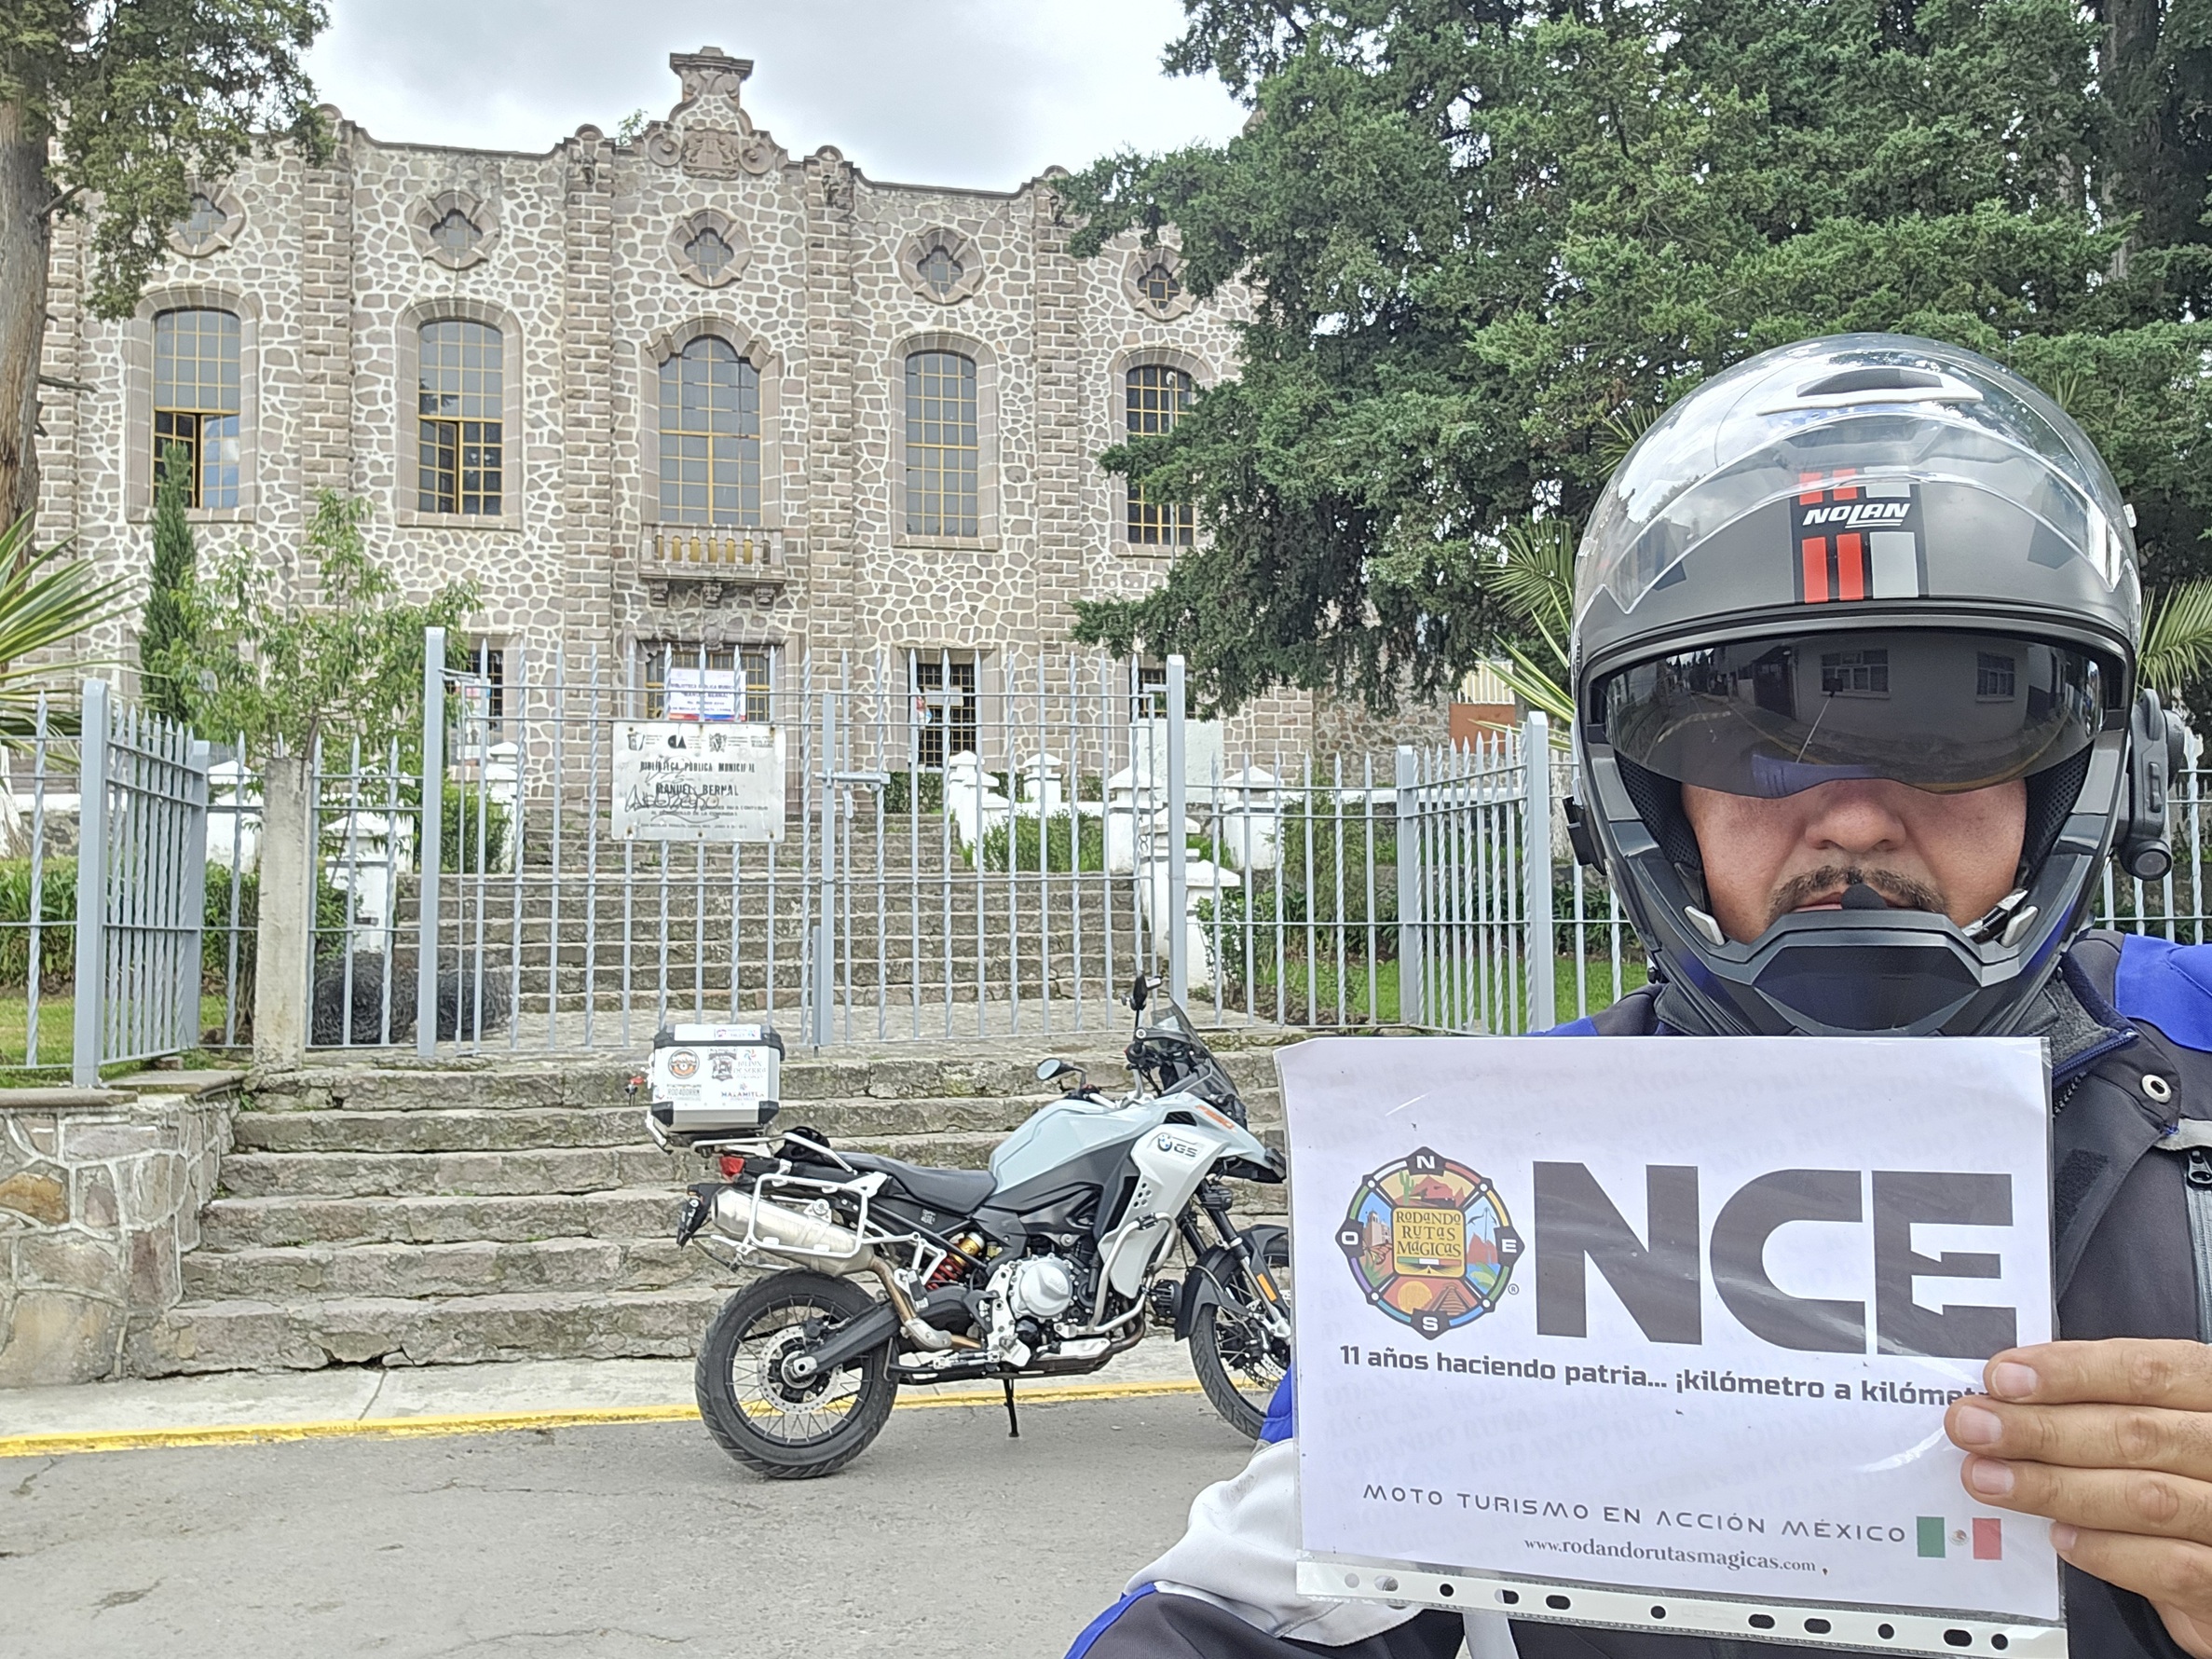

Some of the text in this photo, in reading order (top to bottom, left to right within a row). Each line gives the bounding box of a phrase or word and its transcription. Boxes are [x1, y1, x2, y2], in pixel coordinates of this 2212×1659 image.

[1802, 503, 1911, 528] NOLAN
[703, 784, 739, 796] BERNAL
[1174, 1144, 1198, 1158] GS
[1416, 1155, 1435, 1169] N
[1341, 1231, 1359, 1245] O
[1501, 1240, 1518, 1254] E
[1422, 1317, 1439, 1331] S
[1340, 1345, 1359, 1365] 11
[1367, 1347, 1428, 1370] años
[1437, 1352, 1555, 1380] haciendo
[1565, 1364, 1667, 1387] patria...
[1834, 1382, 1851, 1400] a
[1862, 1379, 1989, 1406] kilóme
[1363, 1484, 1905, 1542] MOTO TURISMO EN ACCIÓN MÉXICO
[1523, 1538, 1816, 1572] www.rodandorutasmagicas.com
